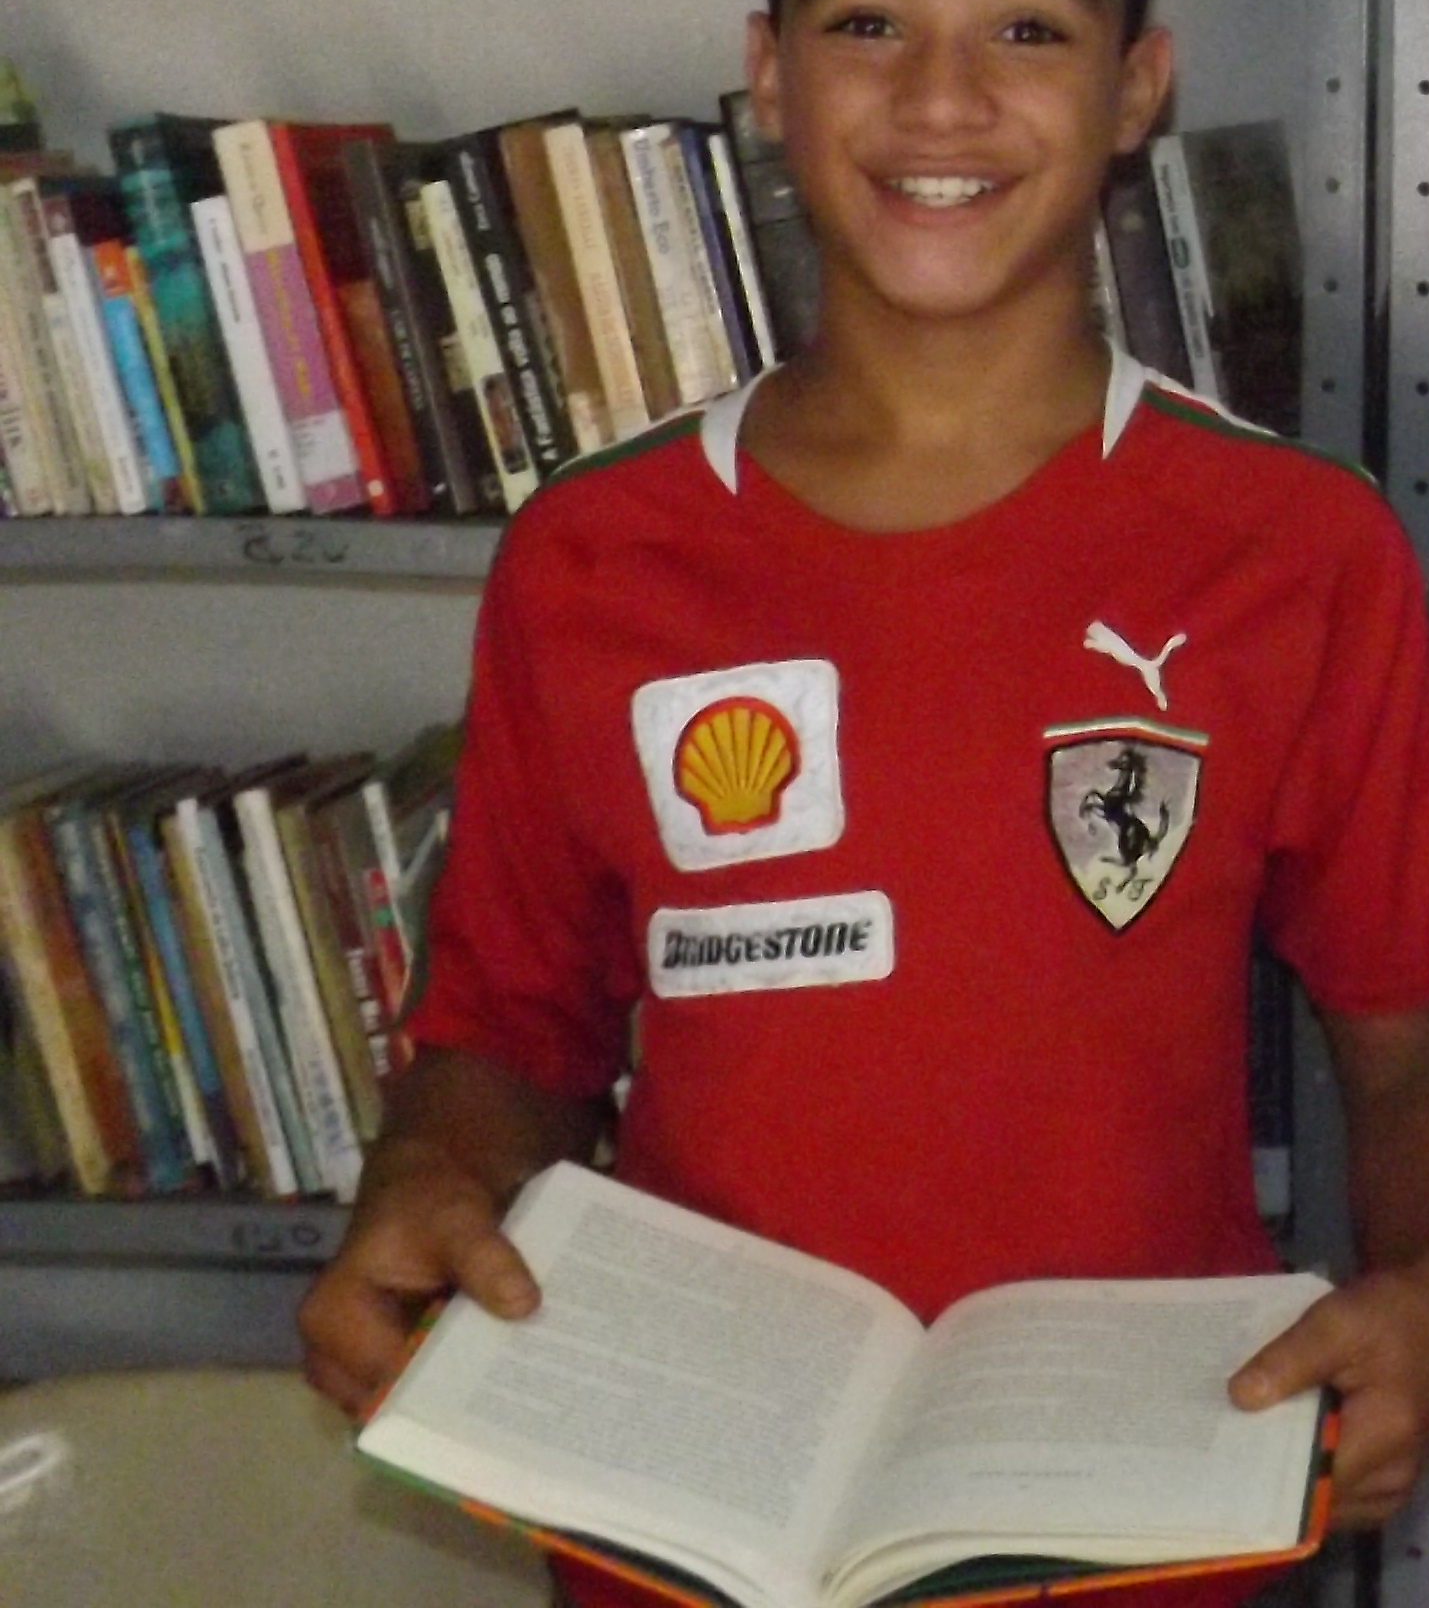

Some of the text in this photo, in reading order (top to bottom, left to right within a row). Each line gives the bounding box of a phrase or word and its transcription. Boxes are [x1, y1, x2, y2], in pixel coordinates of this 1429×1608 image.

[630, 135, 677, 256] Umberto Eco
[662, 920, 874, 970] BRIDGESTONE
